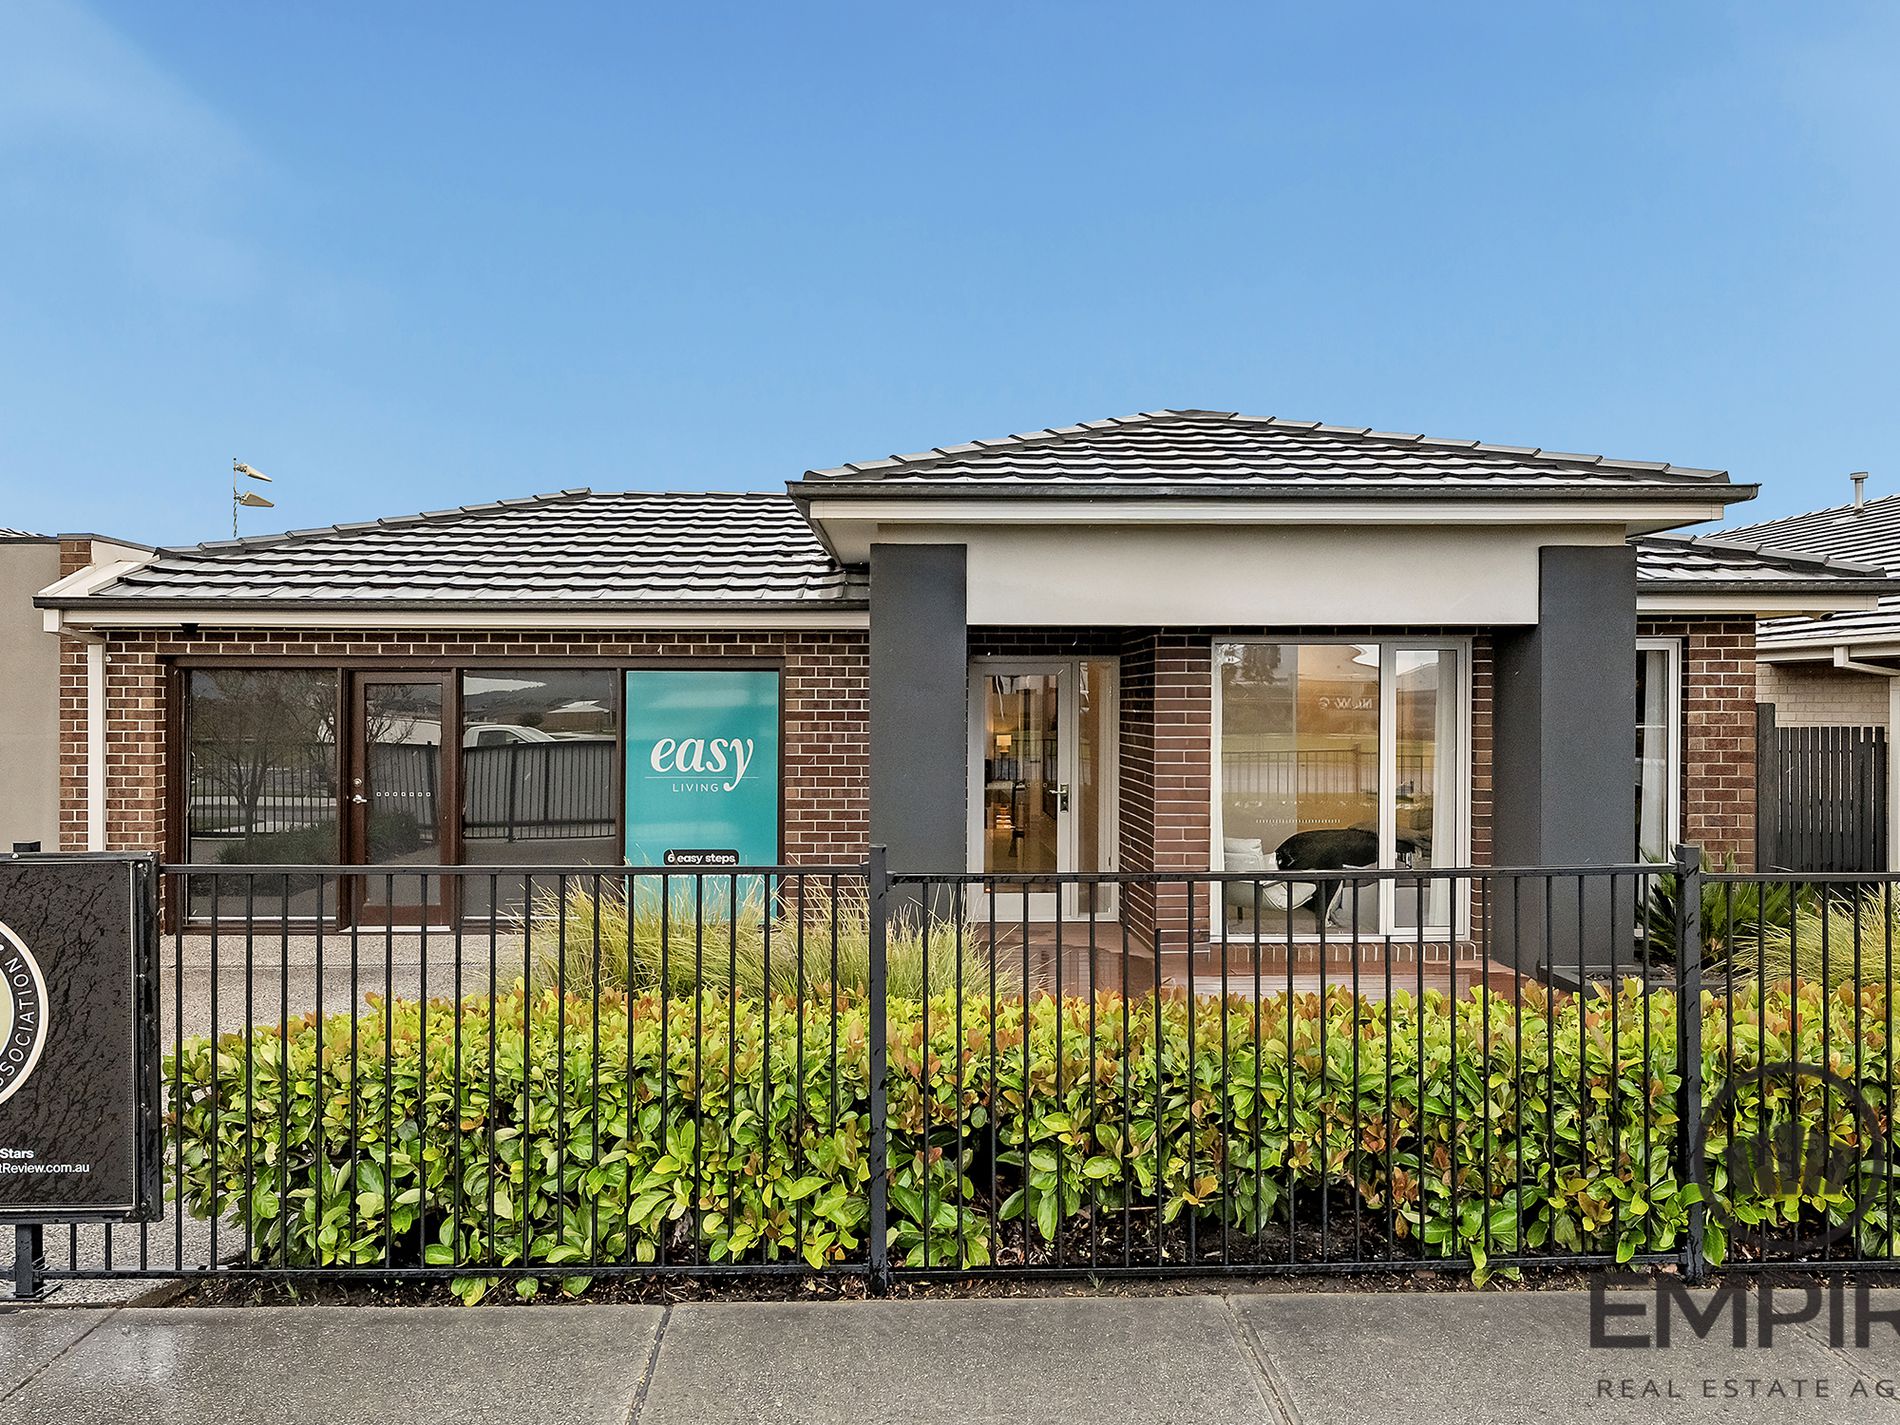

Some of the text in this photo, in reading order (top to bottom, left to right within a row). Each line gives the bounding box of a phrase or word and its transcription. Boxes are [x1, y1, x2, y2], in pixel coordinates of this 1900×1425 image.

[650, 738, 754, 792] easy
[672, 783, 719, 793] LIVING
[667, 853, 736, 865] 6 easy steps
[0, 1148, 34, 1159] Stars
